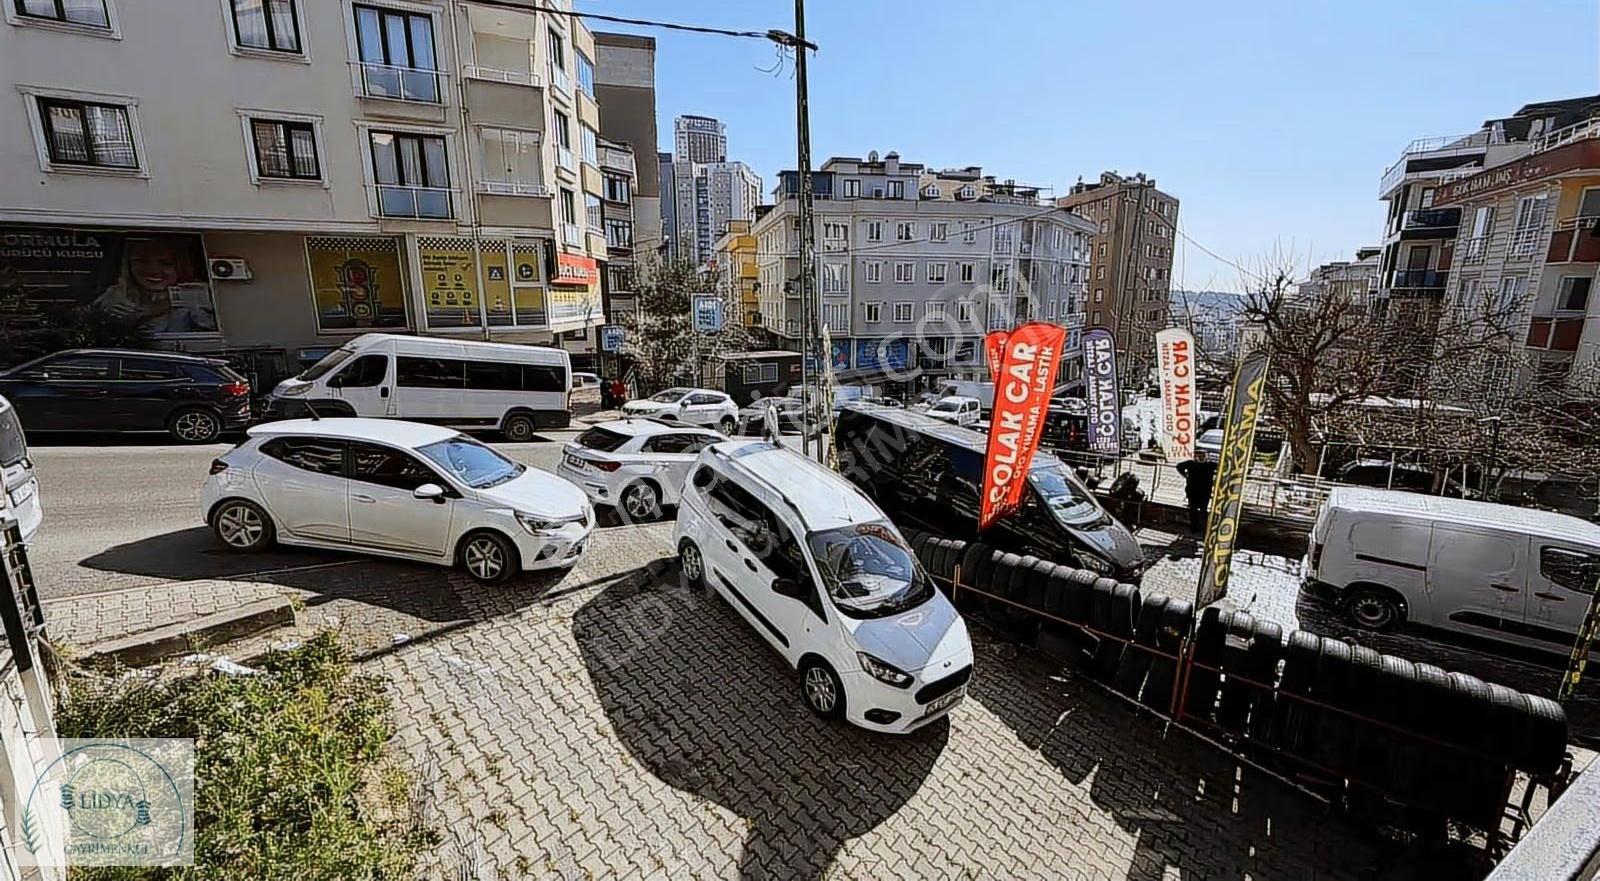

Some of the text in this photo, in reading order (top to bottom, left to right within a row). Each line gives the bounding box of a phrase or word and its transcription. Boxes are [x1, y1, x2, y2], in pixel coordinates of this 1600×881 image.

[1005, 341, 1038, 403] CAR
[1012, 453, 1028, 479] OTO
[1034, 345, 1054, 393] LASTİK
[1214, 376, 1262, 587] OTO YIKAMA
